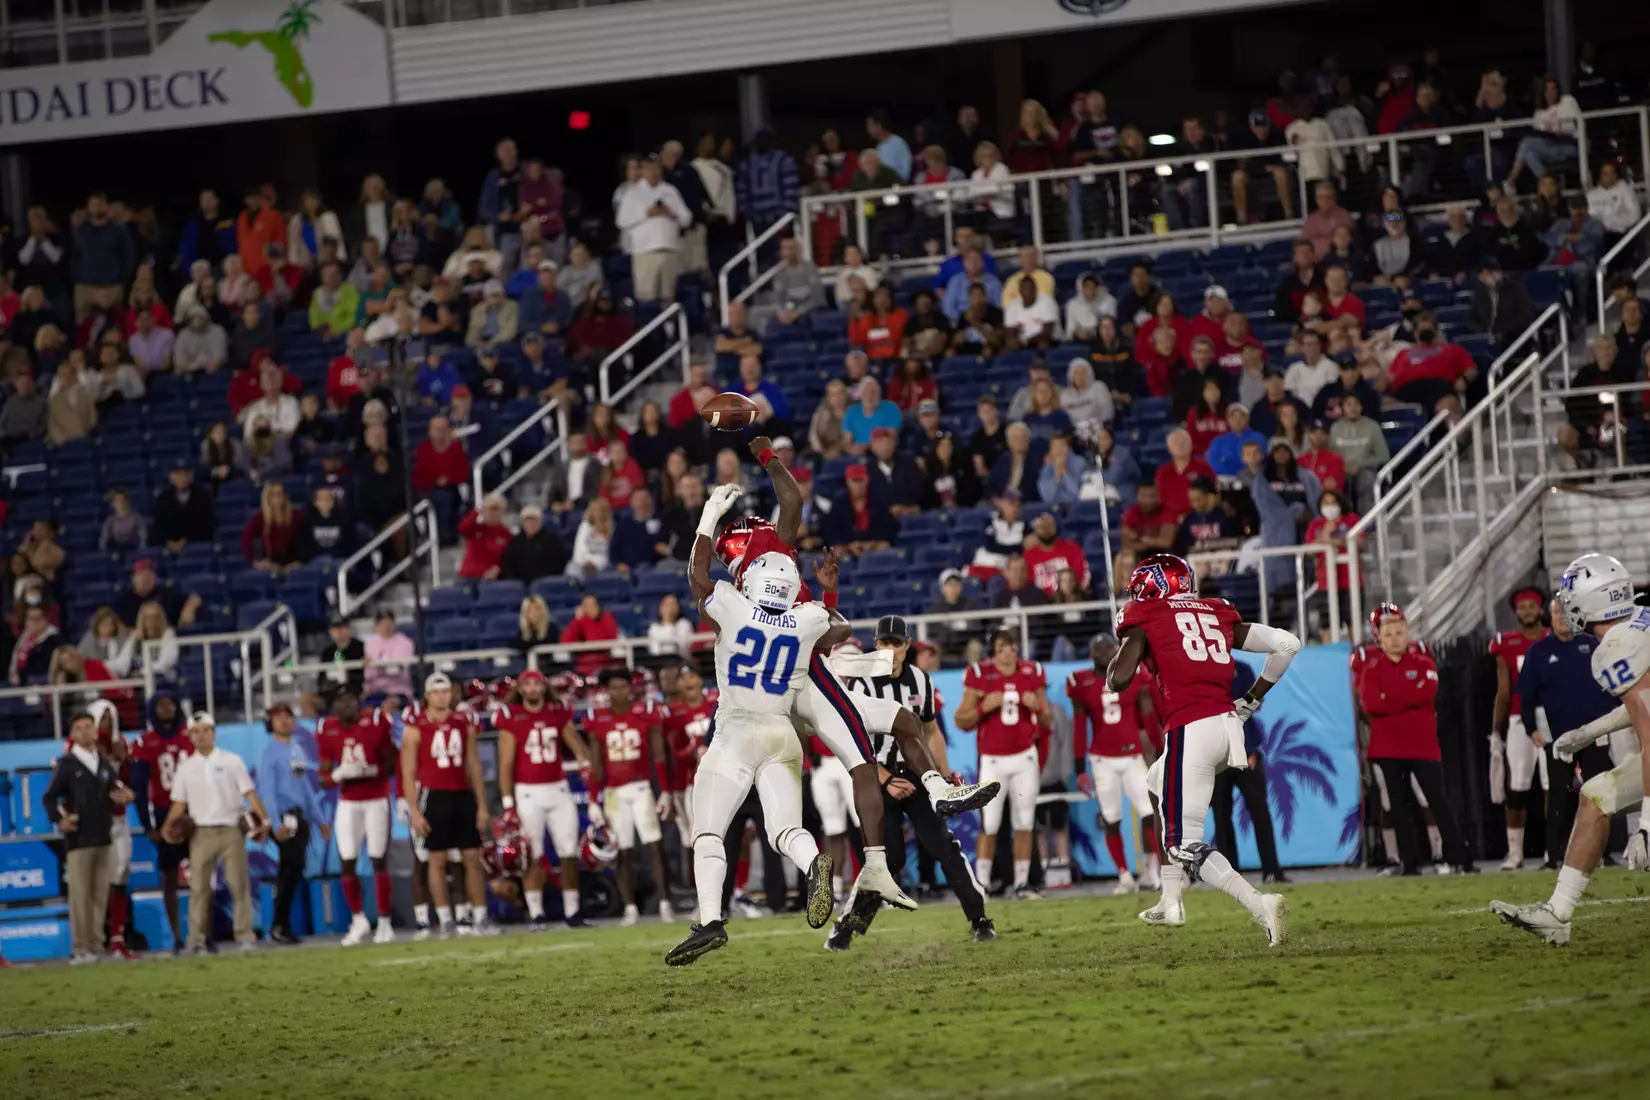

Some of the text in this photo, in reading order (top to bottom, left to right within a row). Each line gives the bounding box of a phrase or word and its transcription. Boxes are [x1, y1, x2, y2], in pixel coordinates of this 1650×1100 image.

[0, 67, 229, 125] DAI DECK
[765, 583, 777, 595] 20
[1609, 590, 1620, 602] 12
[752, 606, 797, 629] THOMAS
[1167, 600, 1214, 611] MITCHELL
[1174, 611, 1231, 665] 85
[728, 625, 800, 695] 20
[1601, 659, 1634, 690] 12
[430, 728, 462, 768] 44
[524, 726, 558, 764] 45
[947, 783, 980, 800] ADIZERO
